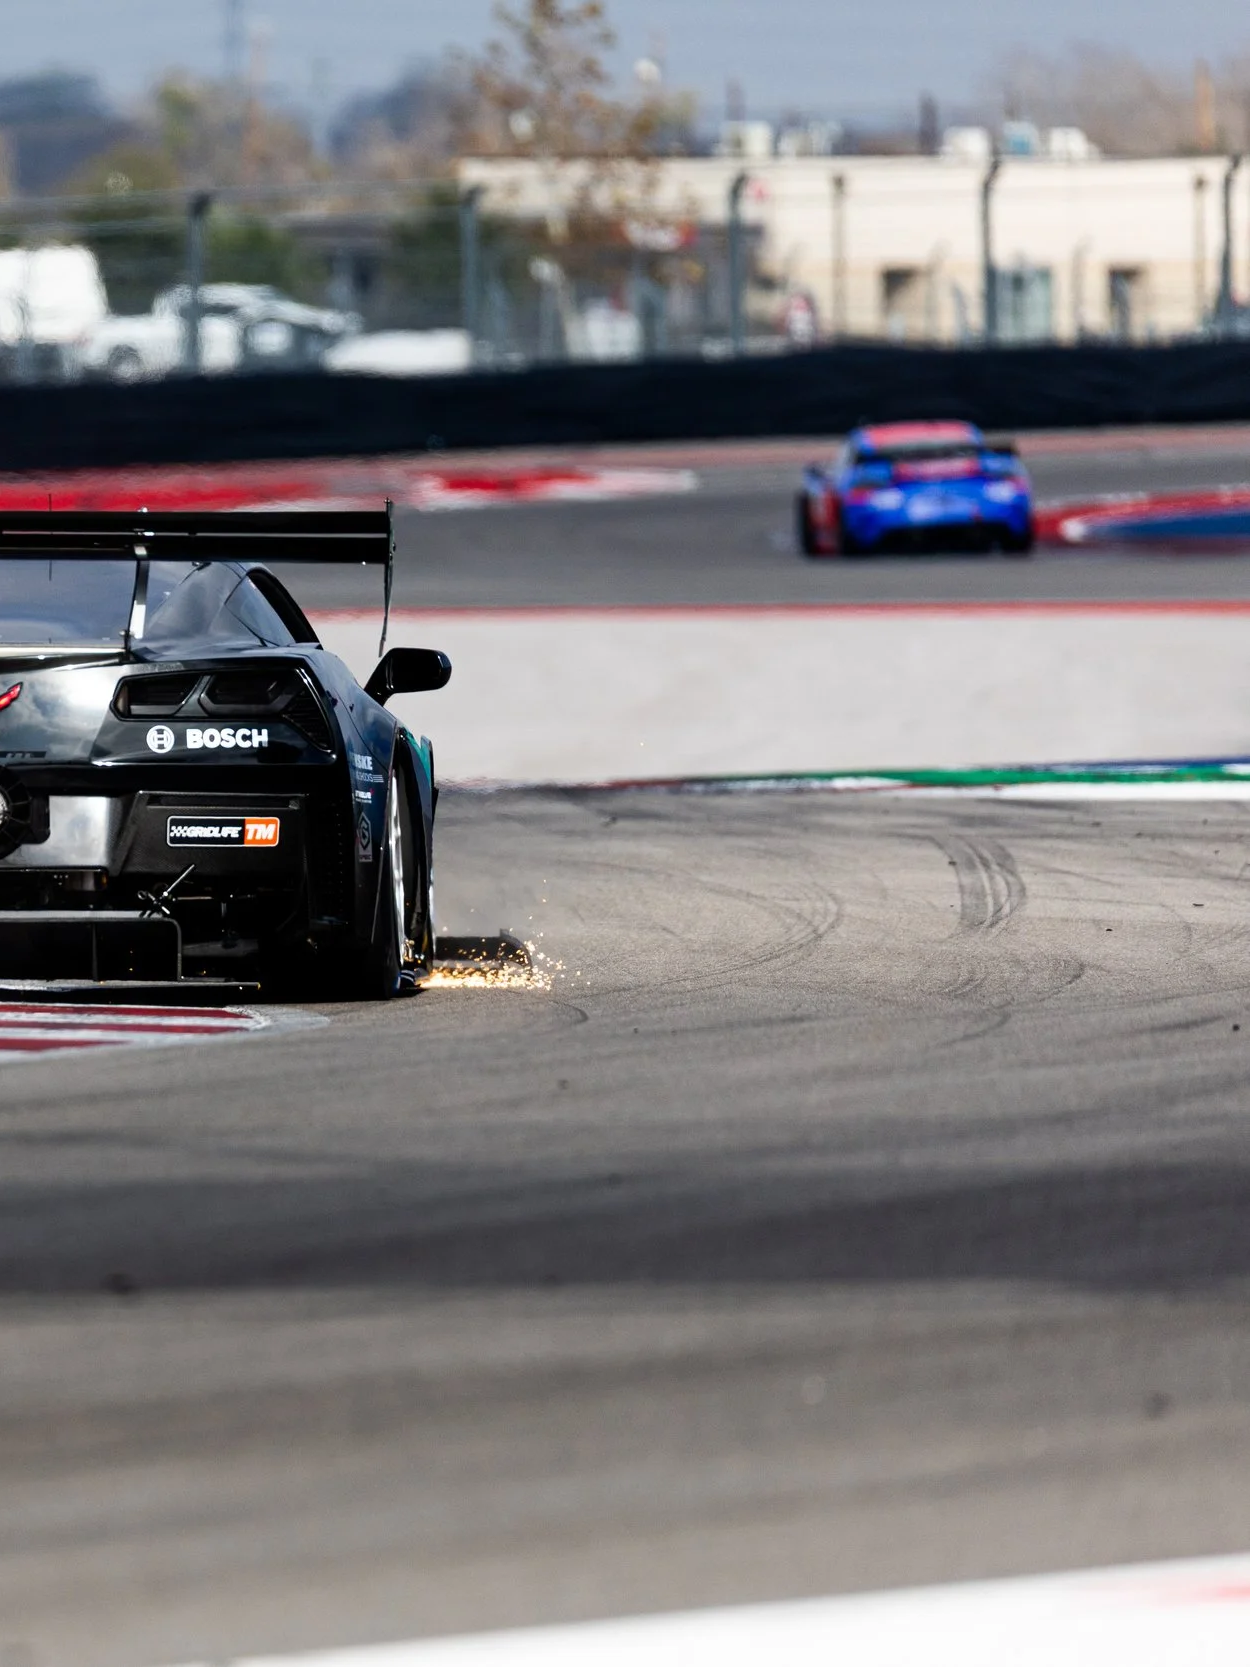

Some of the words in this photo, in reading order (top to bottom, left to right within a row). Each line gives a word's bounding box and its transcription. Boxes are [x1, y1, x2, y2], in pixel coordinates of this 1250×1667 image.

[186, 728, 269, 749] BOSCH
[186, 826, 242, 838] GRIDLIFE
[245, 823, 276, 840] TM
